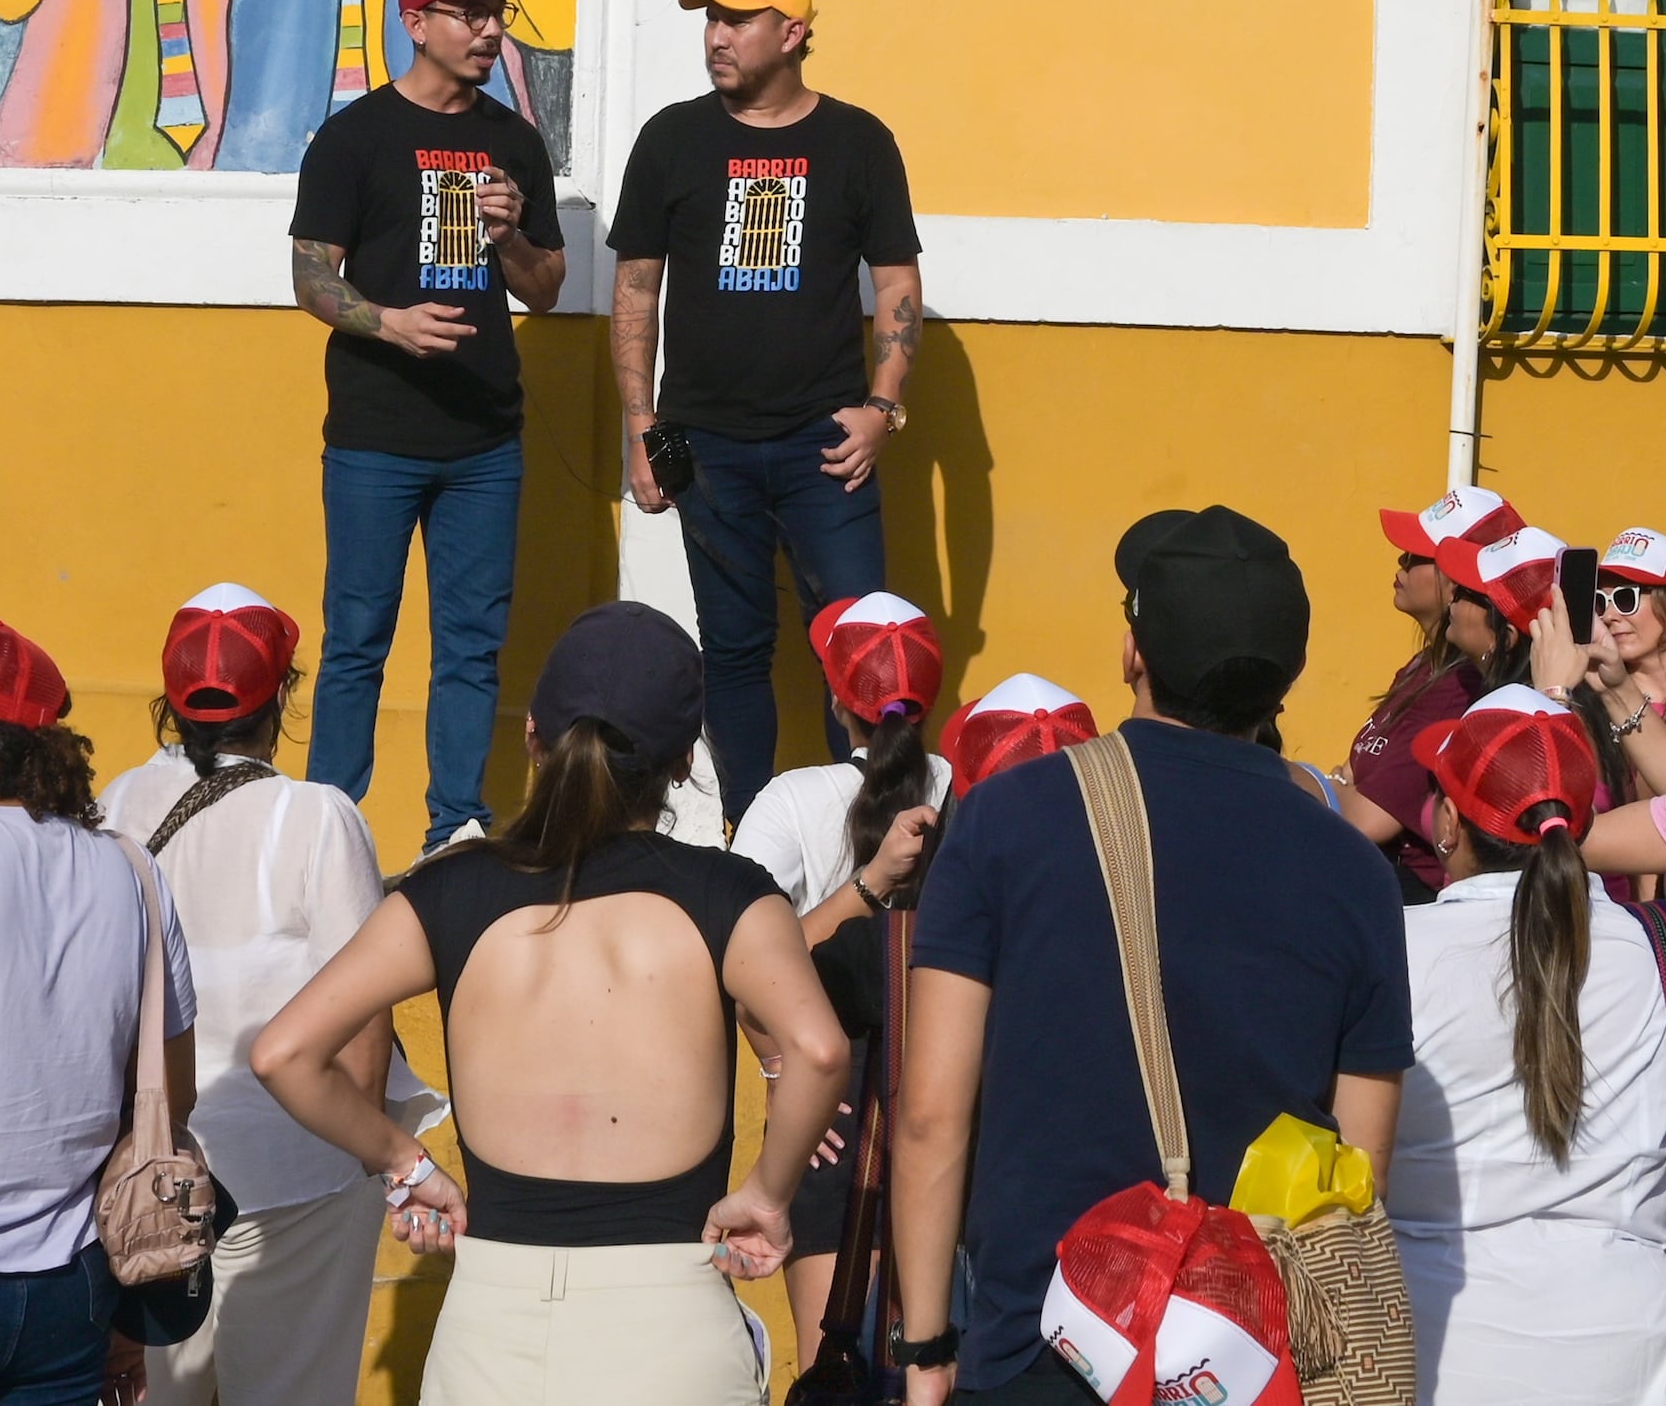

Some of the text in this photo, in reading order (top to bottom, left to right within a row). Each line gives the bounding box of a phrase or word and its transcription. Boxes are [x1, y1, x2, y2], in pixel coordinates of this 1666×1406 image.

[415, 149, 492, 172] BARRIO
[727, 157, 809, 178] BARRIO
[419, 265, 489, 291] ABAJO
[718, 266, 800, 291] ABAJO
